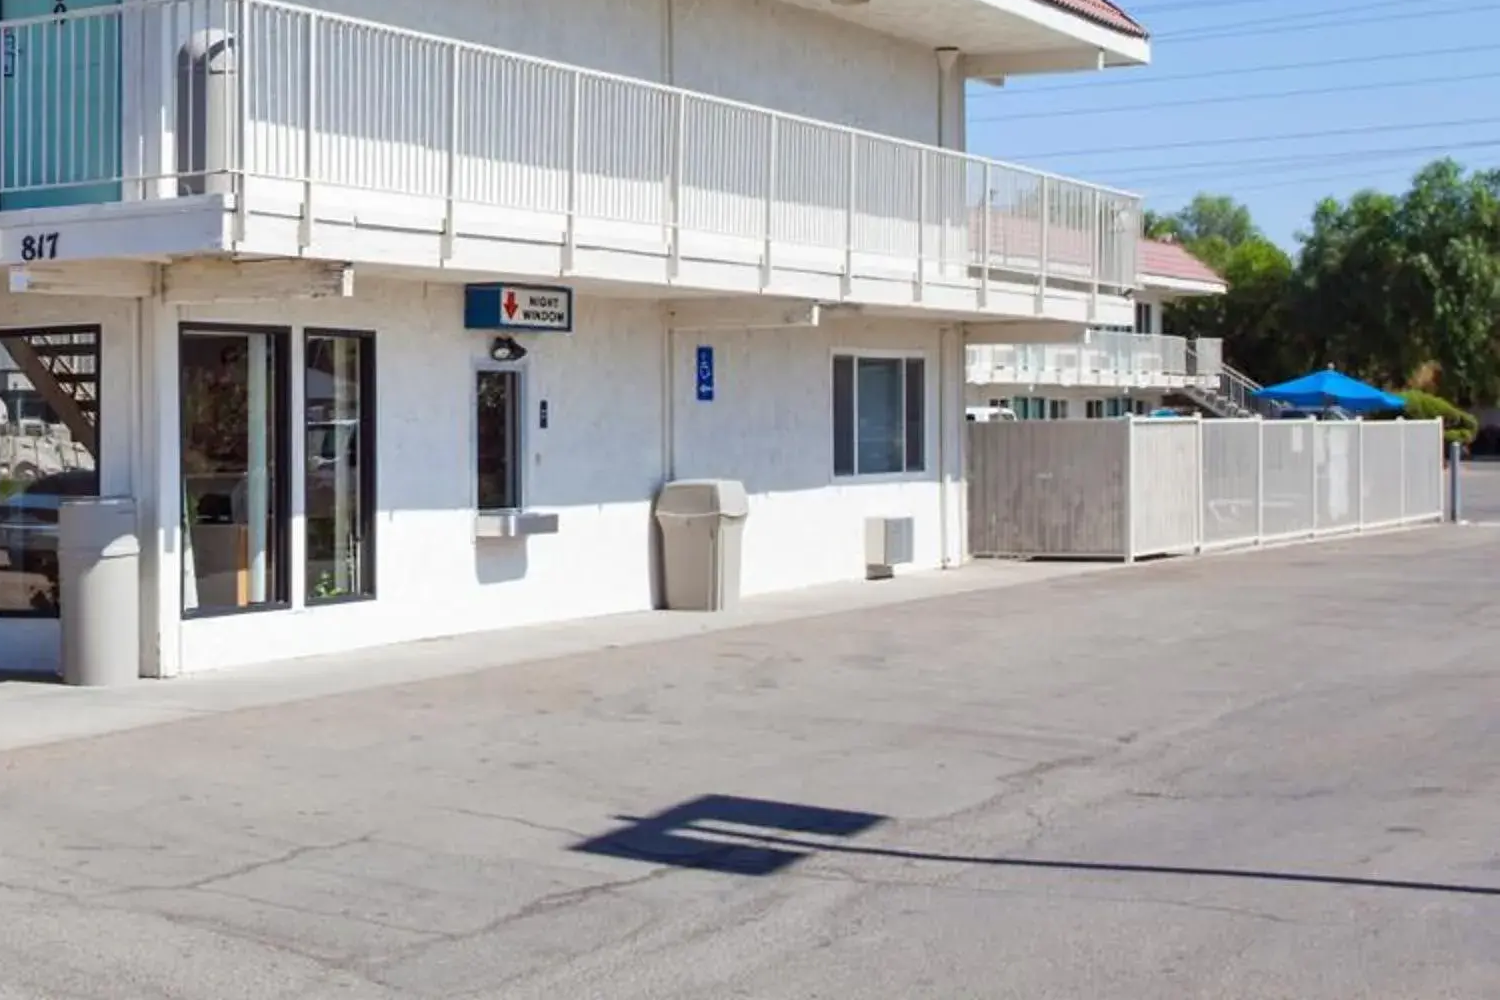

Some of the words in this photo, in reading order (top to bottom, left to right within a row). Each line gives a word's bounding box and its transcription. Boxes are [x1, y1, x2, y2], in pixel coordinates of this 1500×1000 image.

[21, 231, 59, 261] 817
[529, 296, 559, 308] NIGHT
[522, 310, 565, 323] WINDOW
